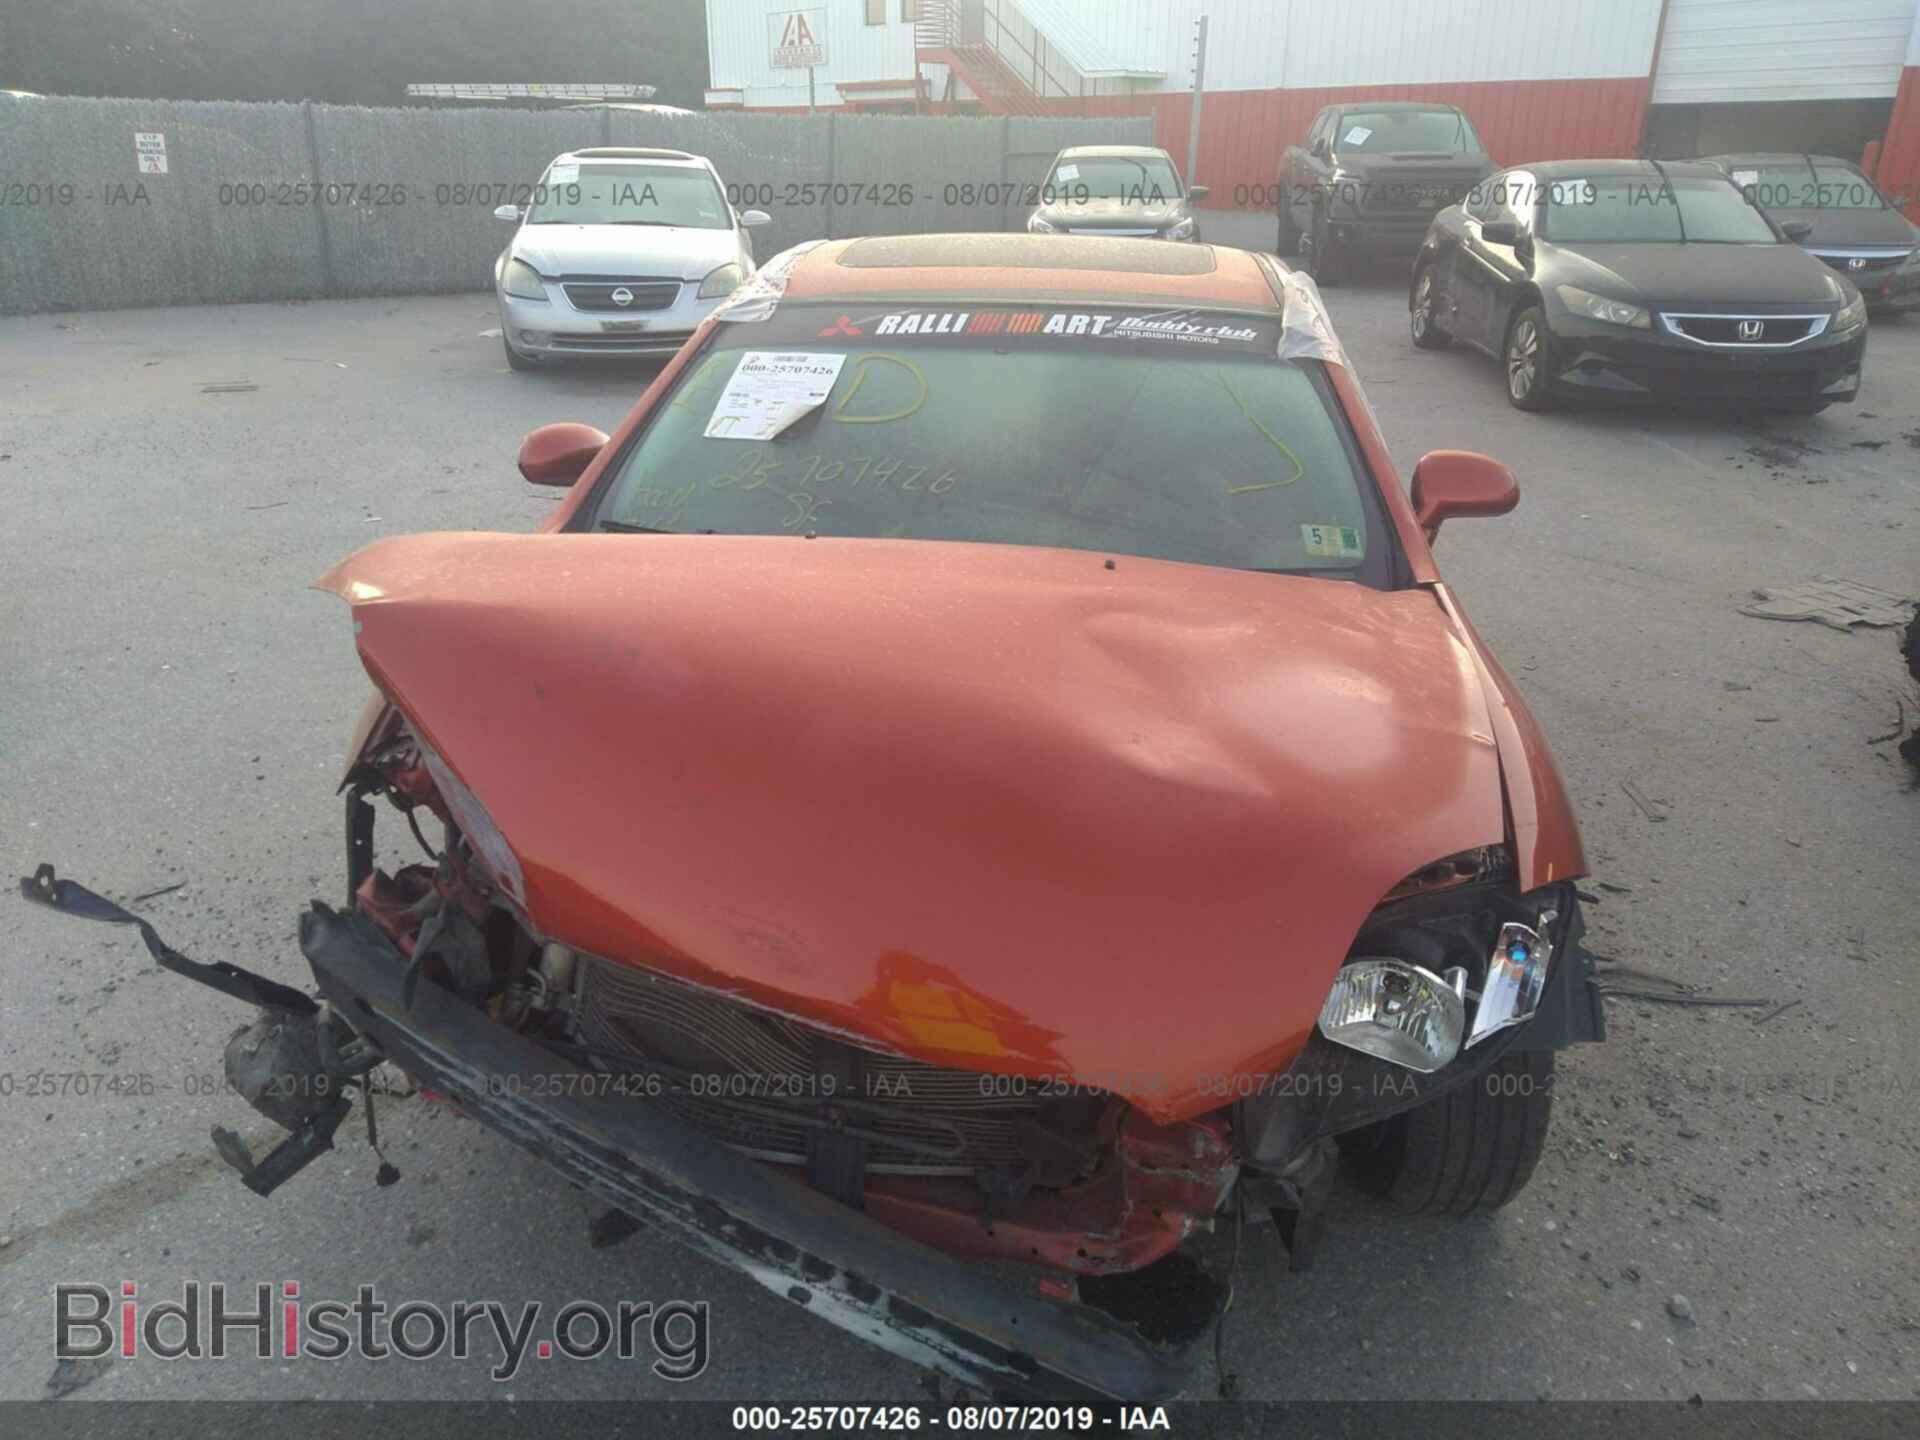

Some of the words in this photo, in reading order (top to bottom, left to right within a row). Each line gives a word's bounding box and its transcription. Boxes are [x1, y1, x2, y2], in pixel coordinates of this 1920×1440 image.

[876, 313, 970, 335] RALLI
[1043, 314, 1112, 336] ART
[1113, 329, 1174, 340] MITSUBISHI
[1176, 334, 1219, 345] MOTORS
[741, 363, 834, 376] 000-25707426
[832, 352, 929, 425] D
[1311, 528, 1322, 545] 5
